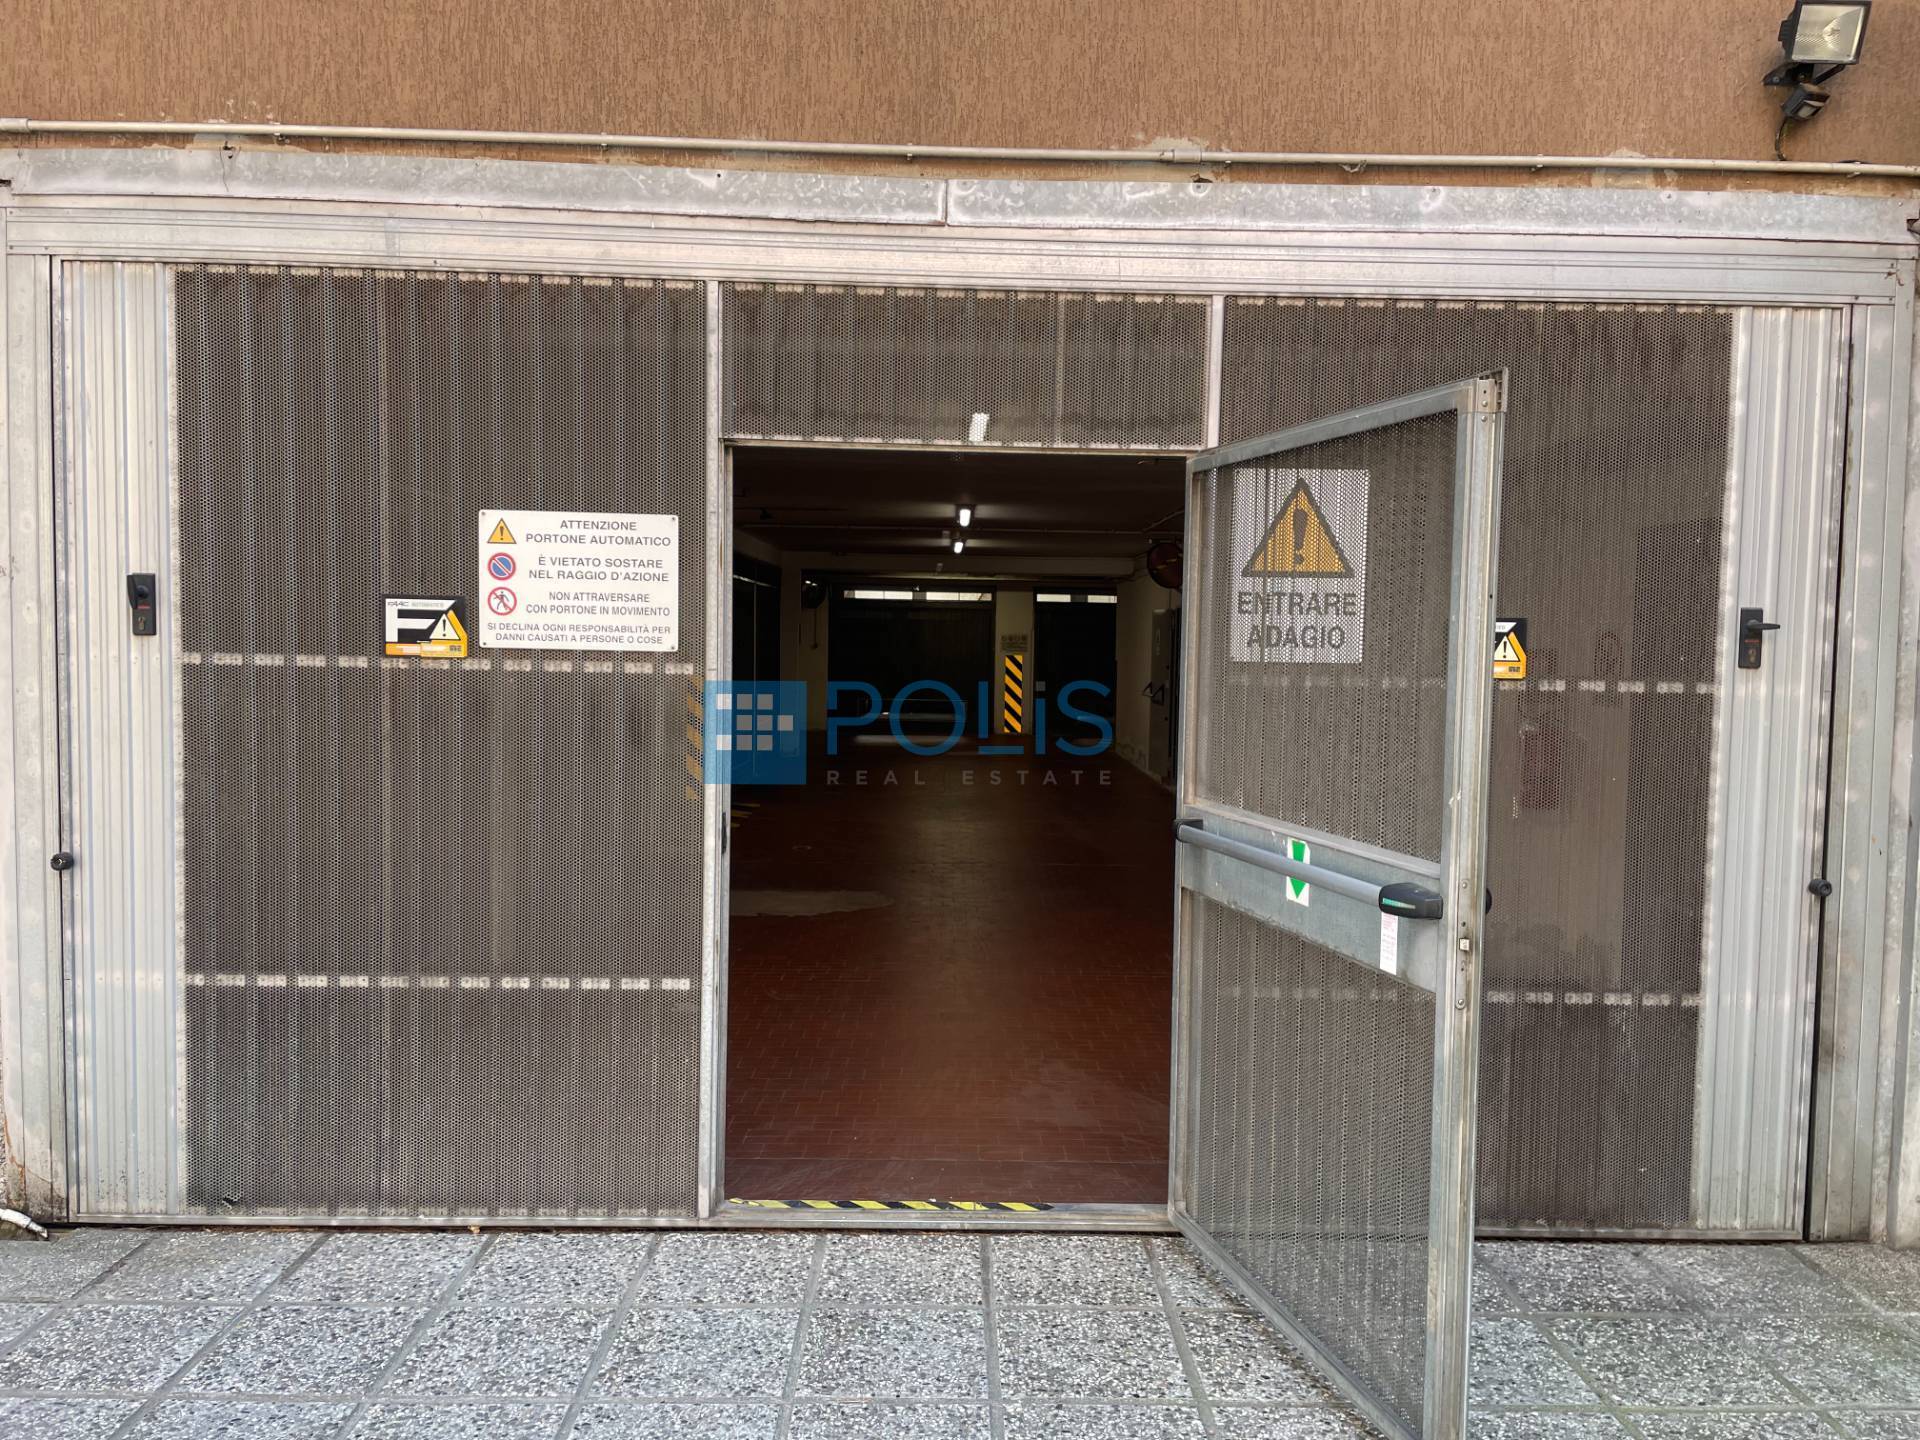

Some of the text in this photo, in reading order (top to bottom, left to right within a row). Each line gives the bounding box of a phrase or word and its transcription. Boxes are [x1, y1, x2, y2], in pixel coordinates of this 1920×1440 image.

[560, 519, 637, 531] ATTENZIONE
[526, 533, 671, 546] PORTONE AUTOMATICO
[538, 554, 663, 569] È VIETATO SOSTARE
[529, 570, 669, 582] NEL RAGGIO D'AZIONE
[549, 592, 650, 603] NON ATTRAVERSARE
[526, 604, 670, 616] CON PORTONE IN MOVIMENTO
[1237, 591, 1358, 617] ENTRARE
[487, 622, 496, 630] SI
[499, 623, 540, 631] DECLINA
[569, 623, 649, 633] RESPONSABILITÀ
[652, 626, 671, 634] PER
[495, 633, 525, 641] DANNI
[527, 633, 568, 642] CAUSATI
[579, 635, 625, 643] PERSONE
[627, 636, 634, 644] O
[636, 636, 662, 645] COSE
[1247, 625, 1346, 650] ADAGIO
